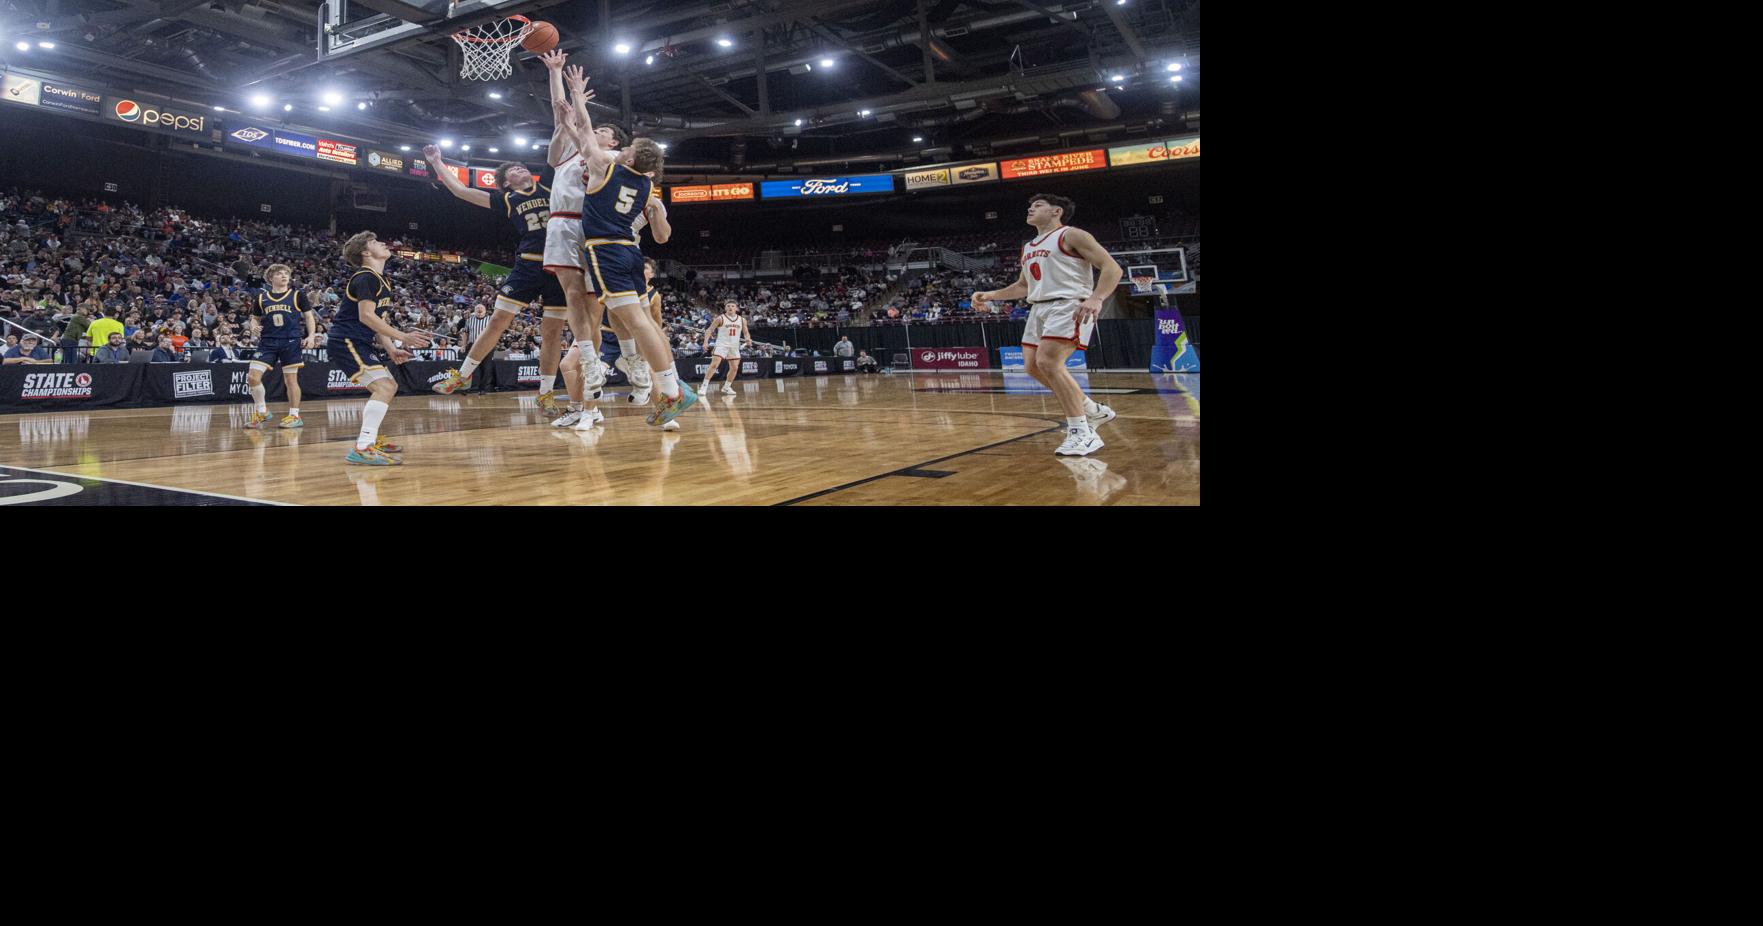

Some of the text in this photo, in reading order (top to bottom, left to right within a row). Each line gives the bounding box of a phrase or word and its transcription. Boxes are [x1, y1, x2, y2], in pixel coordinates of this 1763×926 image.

[44, 85, 100, 102] Corwin Ford
[143, 110, 204, 132] pepsi
[242, 130, 258, 139] TDS
[1147, 145, 1200, 158] Coors
[800, 179, 848, 195] Ford
[614, 186, 638, 214] 5
[516, 198, 550, 215] WENDEL
[264, 304, 292, 315] WENDELL
[272, 314, 284, 326] 0
[937, 352, 956, 361] jiffy
[328, 369, 350, 382] STA
[518, 366, 538, 376] STATE
[23, 372, 75, 388] STATE
[176, 374, 209, 382] PROJECT
[232, 372, 245, 383] MY
[22, 387, 92, 397] CHAMPIONSHIPS
[176, 382, 211, 392] FILTER
[230, 384, 241, 394] MY
